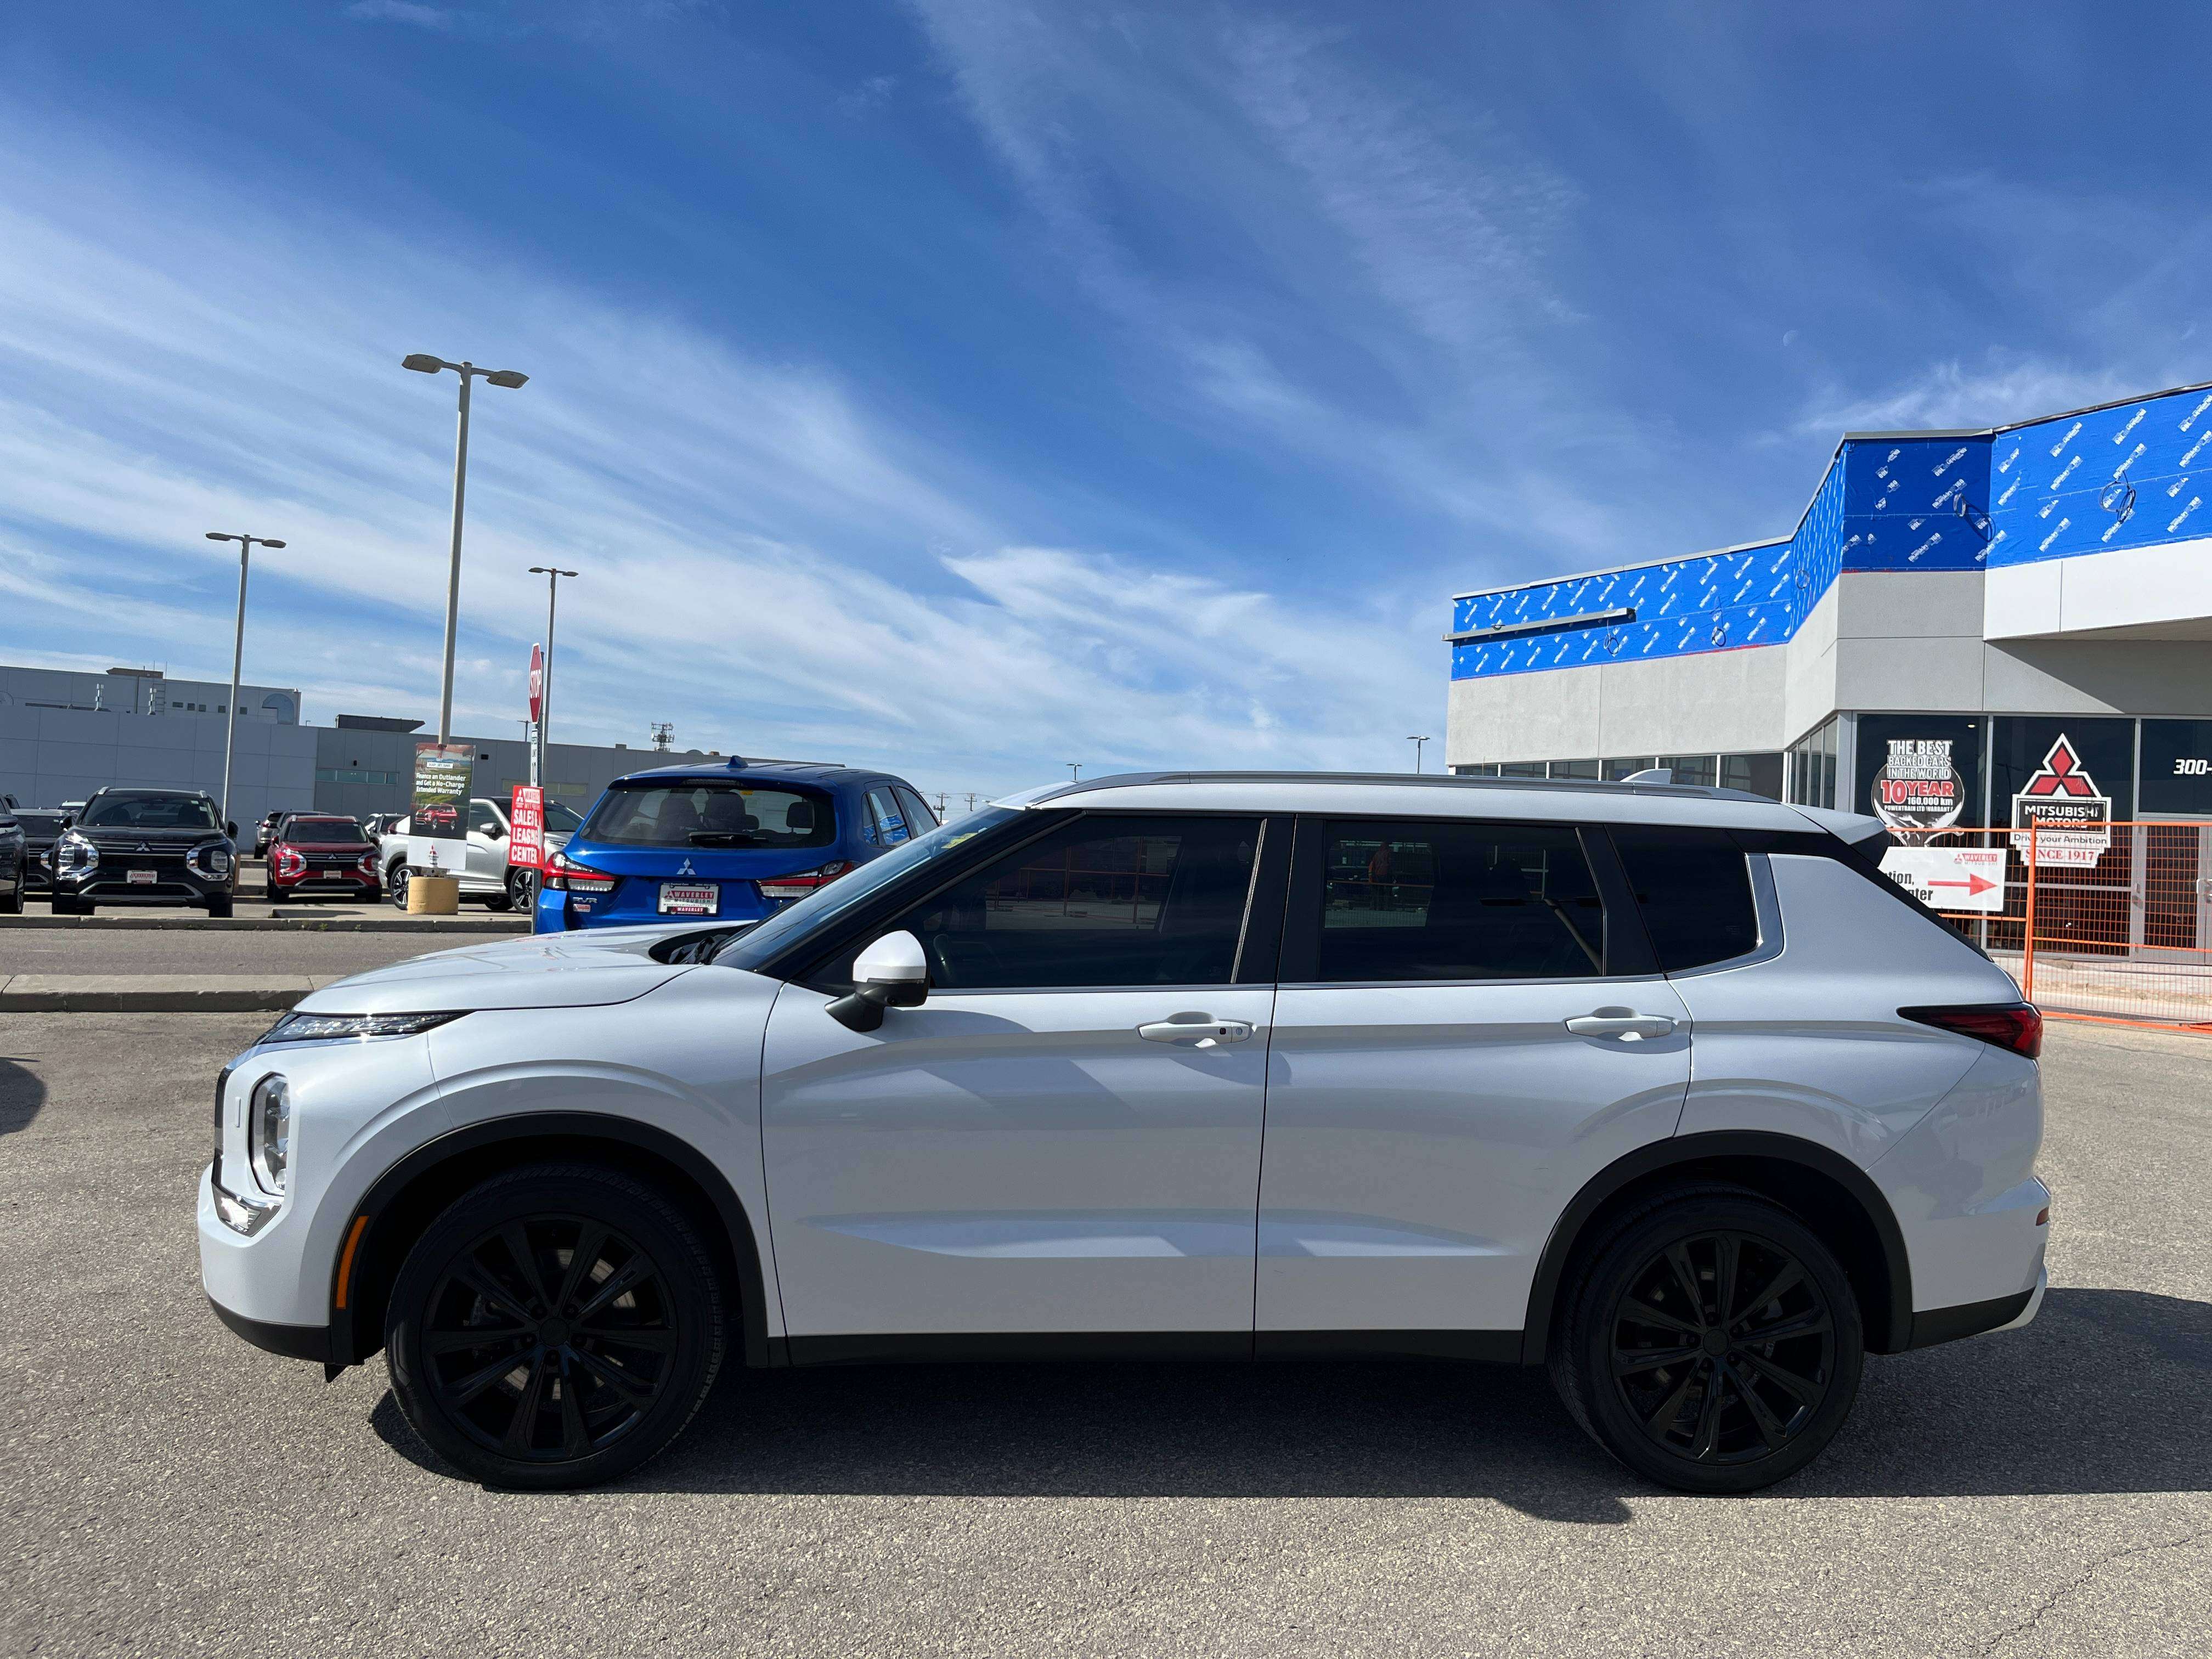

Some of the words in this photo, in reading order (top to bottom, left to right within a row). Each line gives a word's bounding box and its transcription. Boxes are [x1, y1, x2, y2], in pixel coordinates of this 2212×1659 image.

[530, 669, 541, 698] STOP
[1888, 740, 1915, 755] THE
[1917, 740, 1952, 755] BEST
[1888, 755, 1923, 766] BACKED
[1926, 755, 1951, 767] CARS
[1888, 768, 1898, 778] IN
[1899, 768, 1916, 778] THE
[1917, 768, 1951, 779] WORLD
[1881, 780, 1908, 804] 10
[1906, 781, 1954, 797] YEAR
[1940, 797, 1953, 805] km
[2025, 805, 2098, 817] MITSUBISHI
[2063, 836, 2107, 844] Ambition
[512, 845, 537, 864] CENTER
[2025, 850, 2063, 860] SNCE
[2068, 851, 2094, 861] 1917
[1885, 871, 1914, 885] tion,
